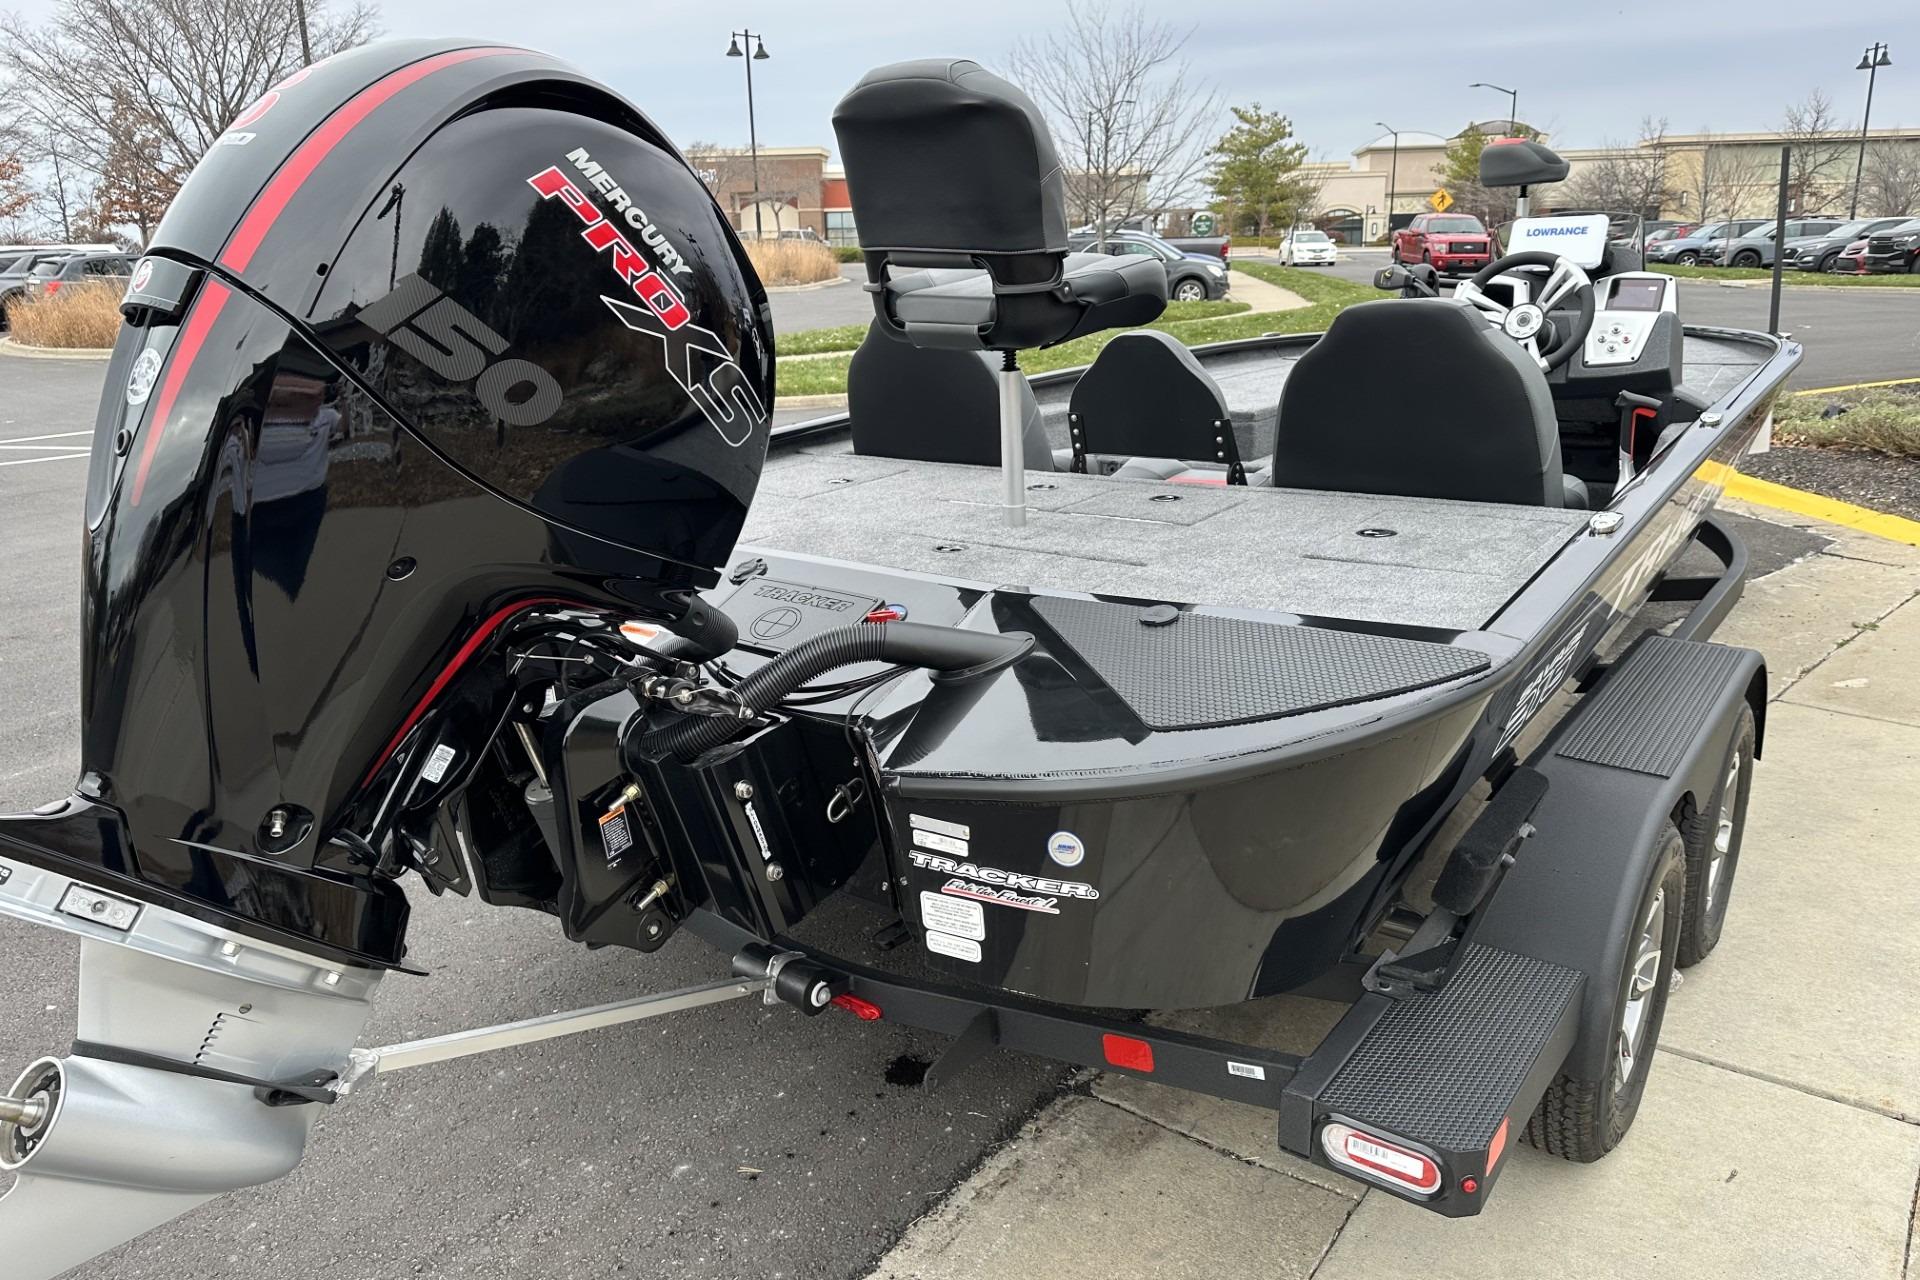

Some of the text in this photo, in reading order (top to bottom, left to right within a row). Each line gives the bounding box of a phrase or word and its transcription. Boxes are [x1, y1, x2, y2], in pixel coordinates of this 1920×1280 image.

[526, 165, 690, 331] PRO
[565, 147, 692, 275] MERCURY
[1526, 226, 1589, 237] LOWRANCE
[355, 272, 563, 426] 150
[600, 266, 766, 447] XS
[753, 585, 855, 612] TRACKER
[908, 850, 1097, 899] TRACKER
[976, 886, 995, 898] the
